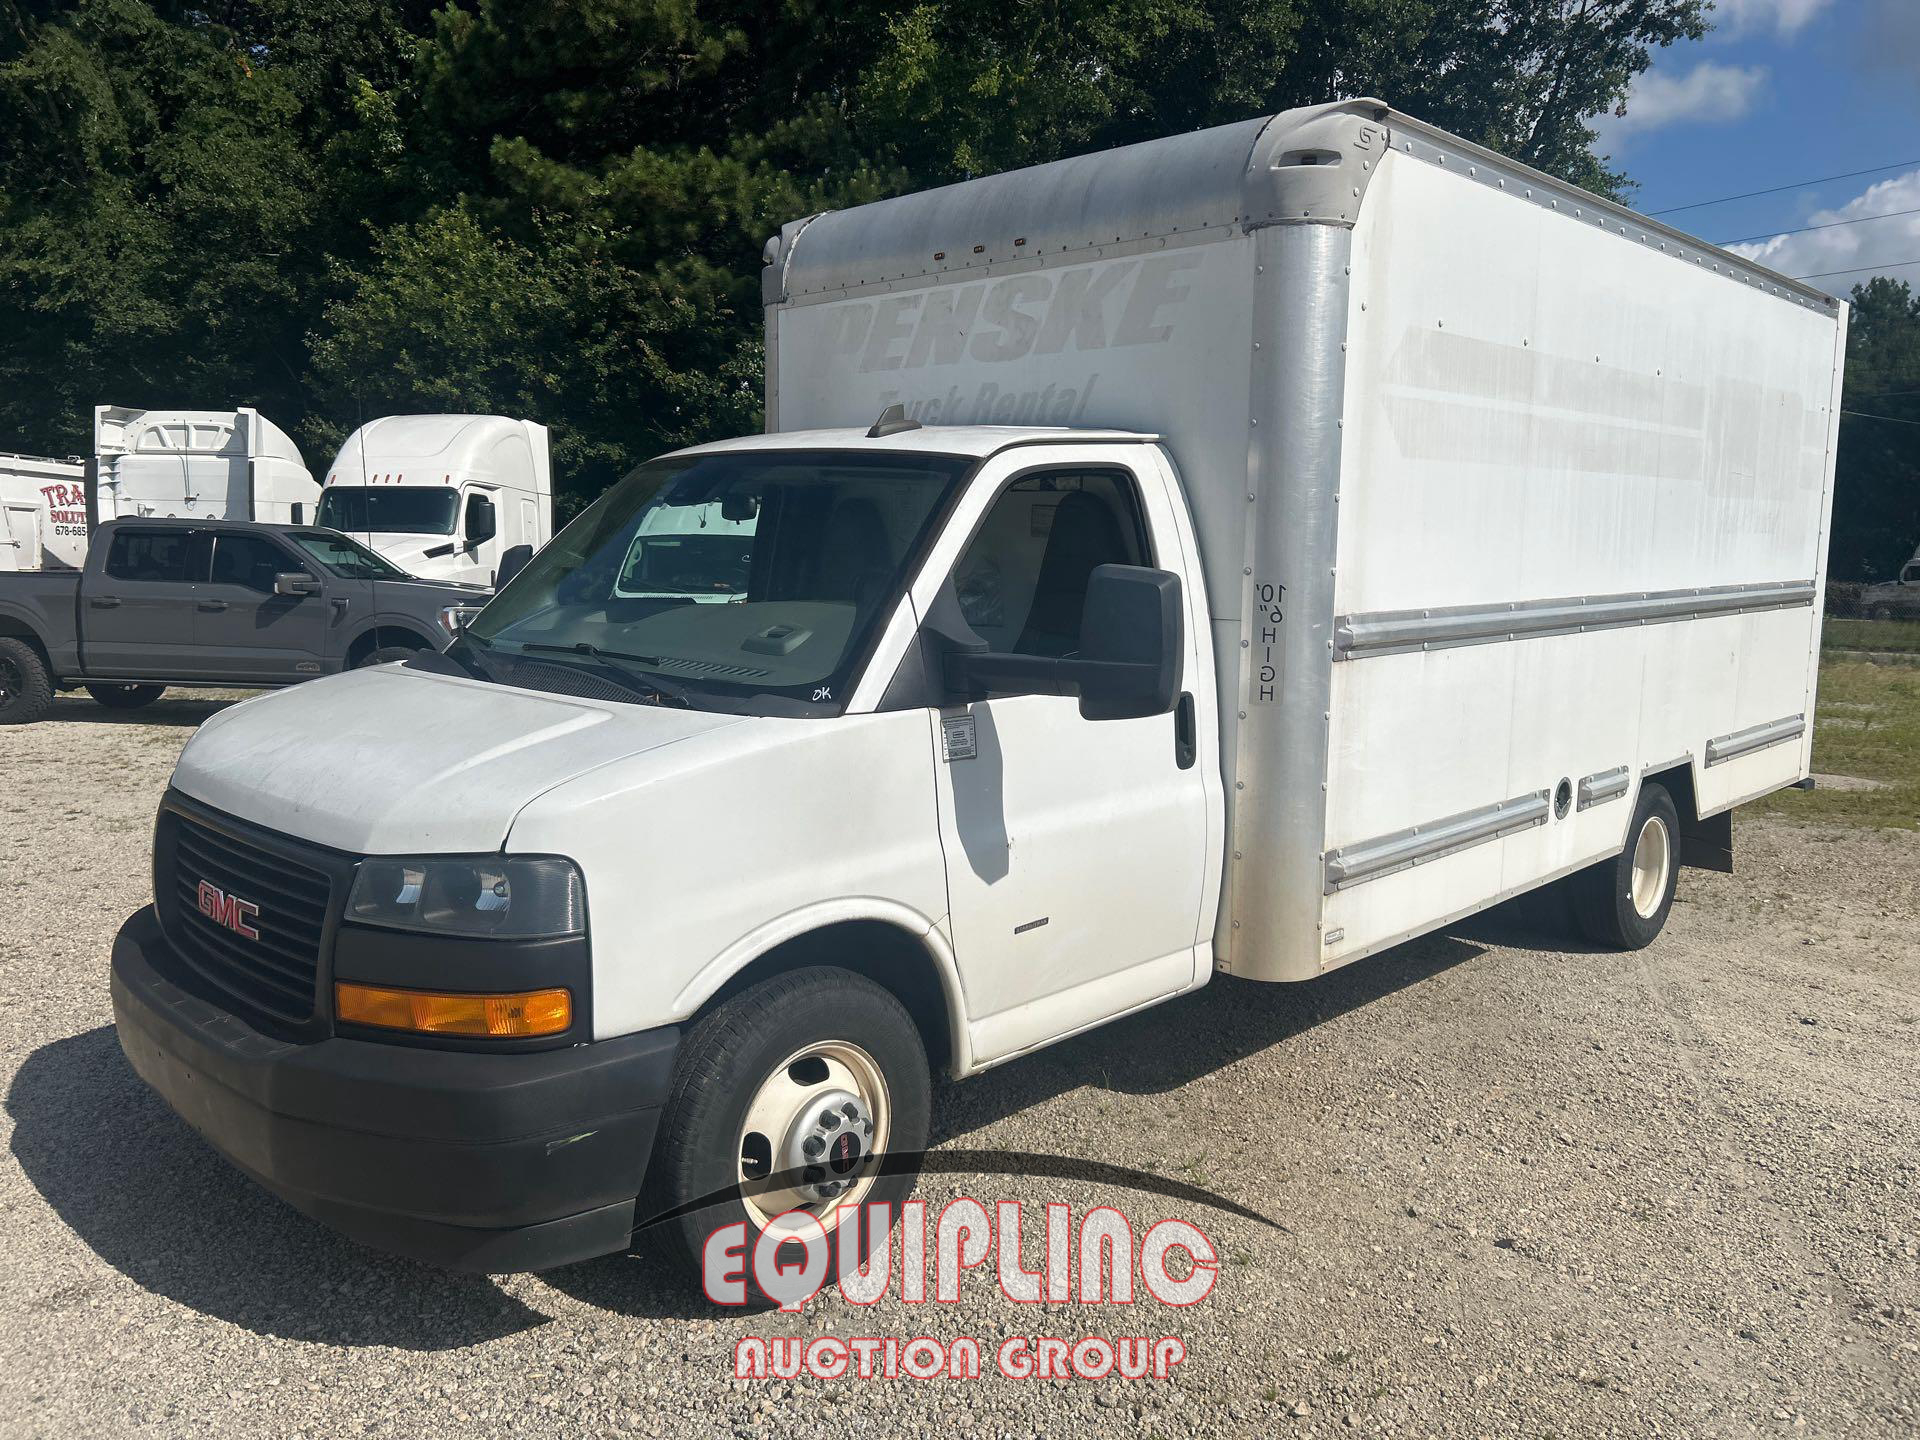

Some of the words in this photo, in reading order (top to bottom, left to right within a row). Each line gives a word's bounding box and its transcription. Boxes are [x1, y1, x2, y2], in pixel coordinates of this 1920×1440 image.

[809, 249, 1206, 379] PENSKE
[878, 385, 964, 425] Tuck
[971, 373, 1099, 425] Rental
[198, 879, 259, 941] GMC
